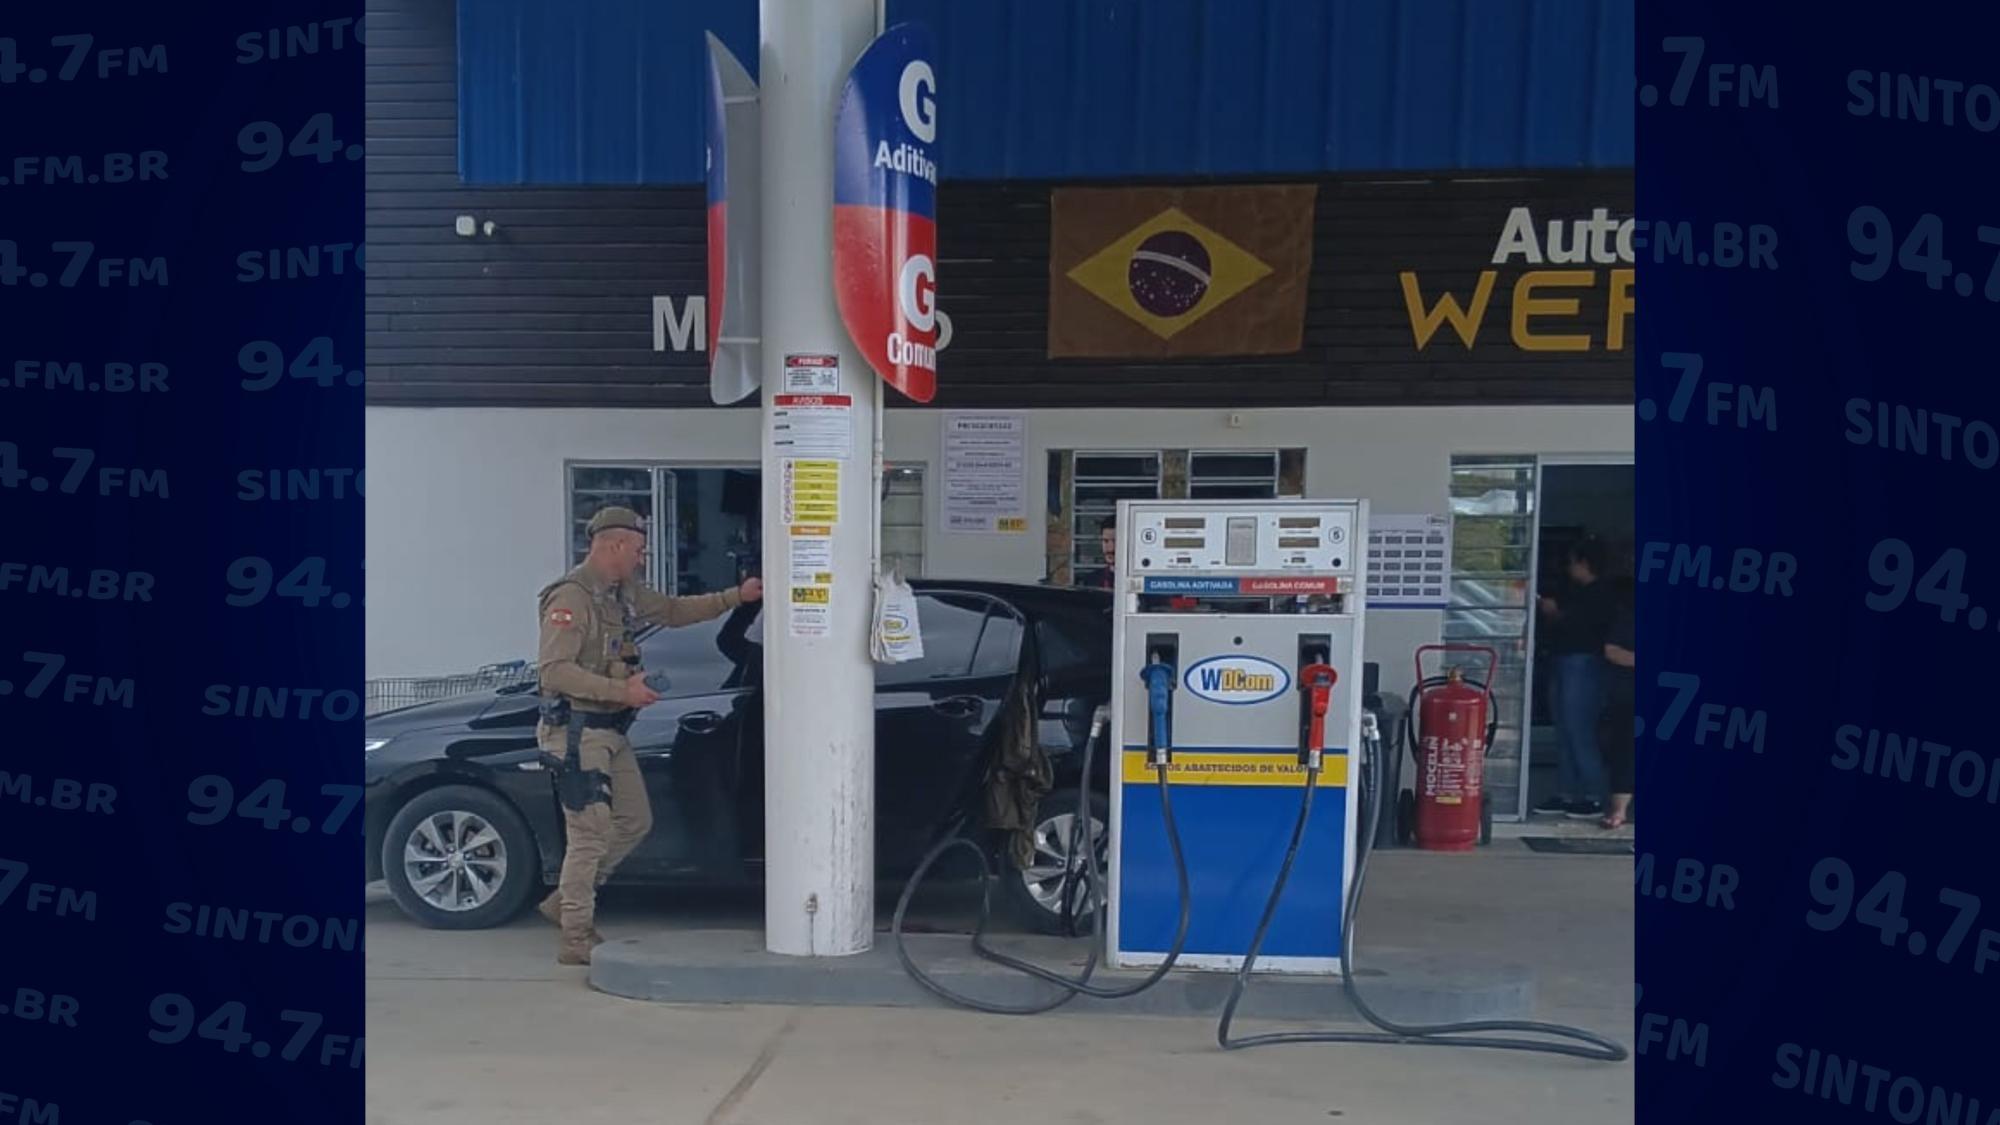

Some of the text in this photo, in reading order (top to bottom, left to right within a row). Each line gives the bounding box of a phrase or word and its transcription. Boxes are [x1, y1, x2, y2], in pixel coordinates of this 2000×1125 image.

[899, 59, 936, 144] G
[899, 254, 935, 332] G
[1150, 580, 1190, 590] GASOLINA
[1200, 667, 1274, 692] WDCom
[1184, 762, 1257, 773] ABASTECIDOS
[1259, 763, 1275, 774] DE
[1423, 735, 1439, 797] MOCELIN
